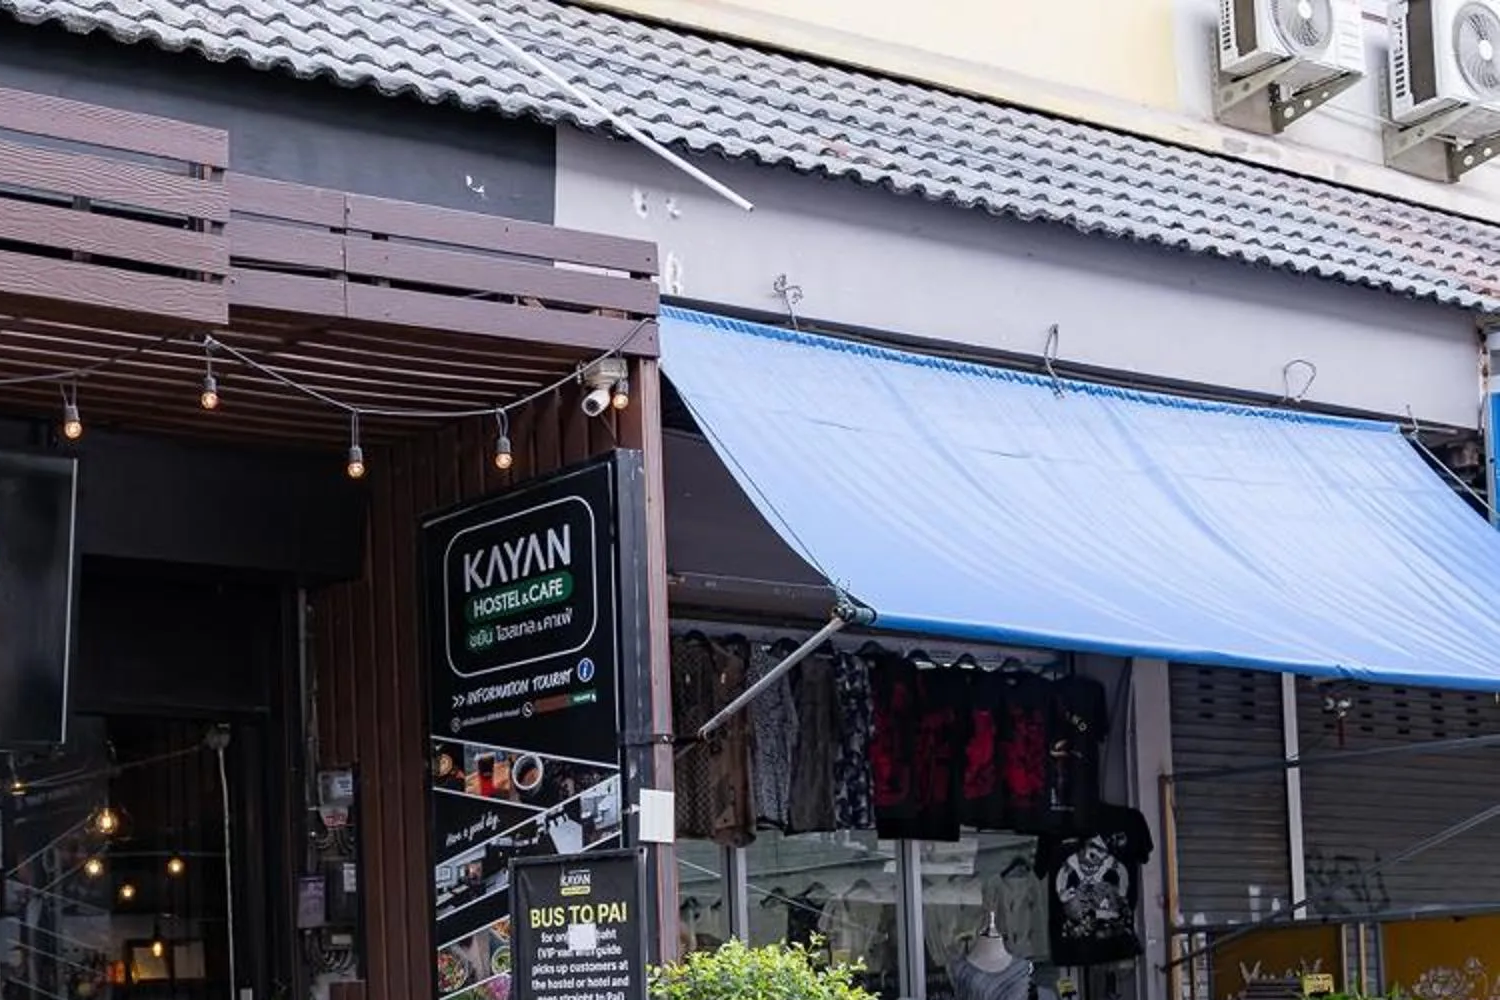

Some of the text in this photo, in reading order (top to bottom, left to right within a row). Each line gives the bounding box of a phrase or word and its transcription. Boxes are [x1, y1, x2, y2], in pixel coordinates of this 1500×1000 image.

[464, 523, 571, 593] KAYAN
[466, 679, 529, 705] INFORMATION
[532, 667, 574, 690] TOURIST
[530, 901, 627, 929] BUS TO PAI
[596, 944, 622, 959] guide
[532, 960, 629, 977] picks up customers at
[531, 975, 629, 990] the hostel or hotel and
